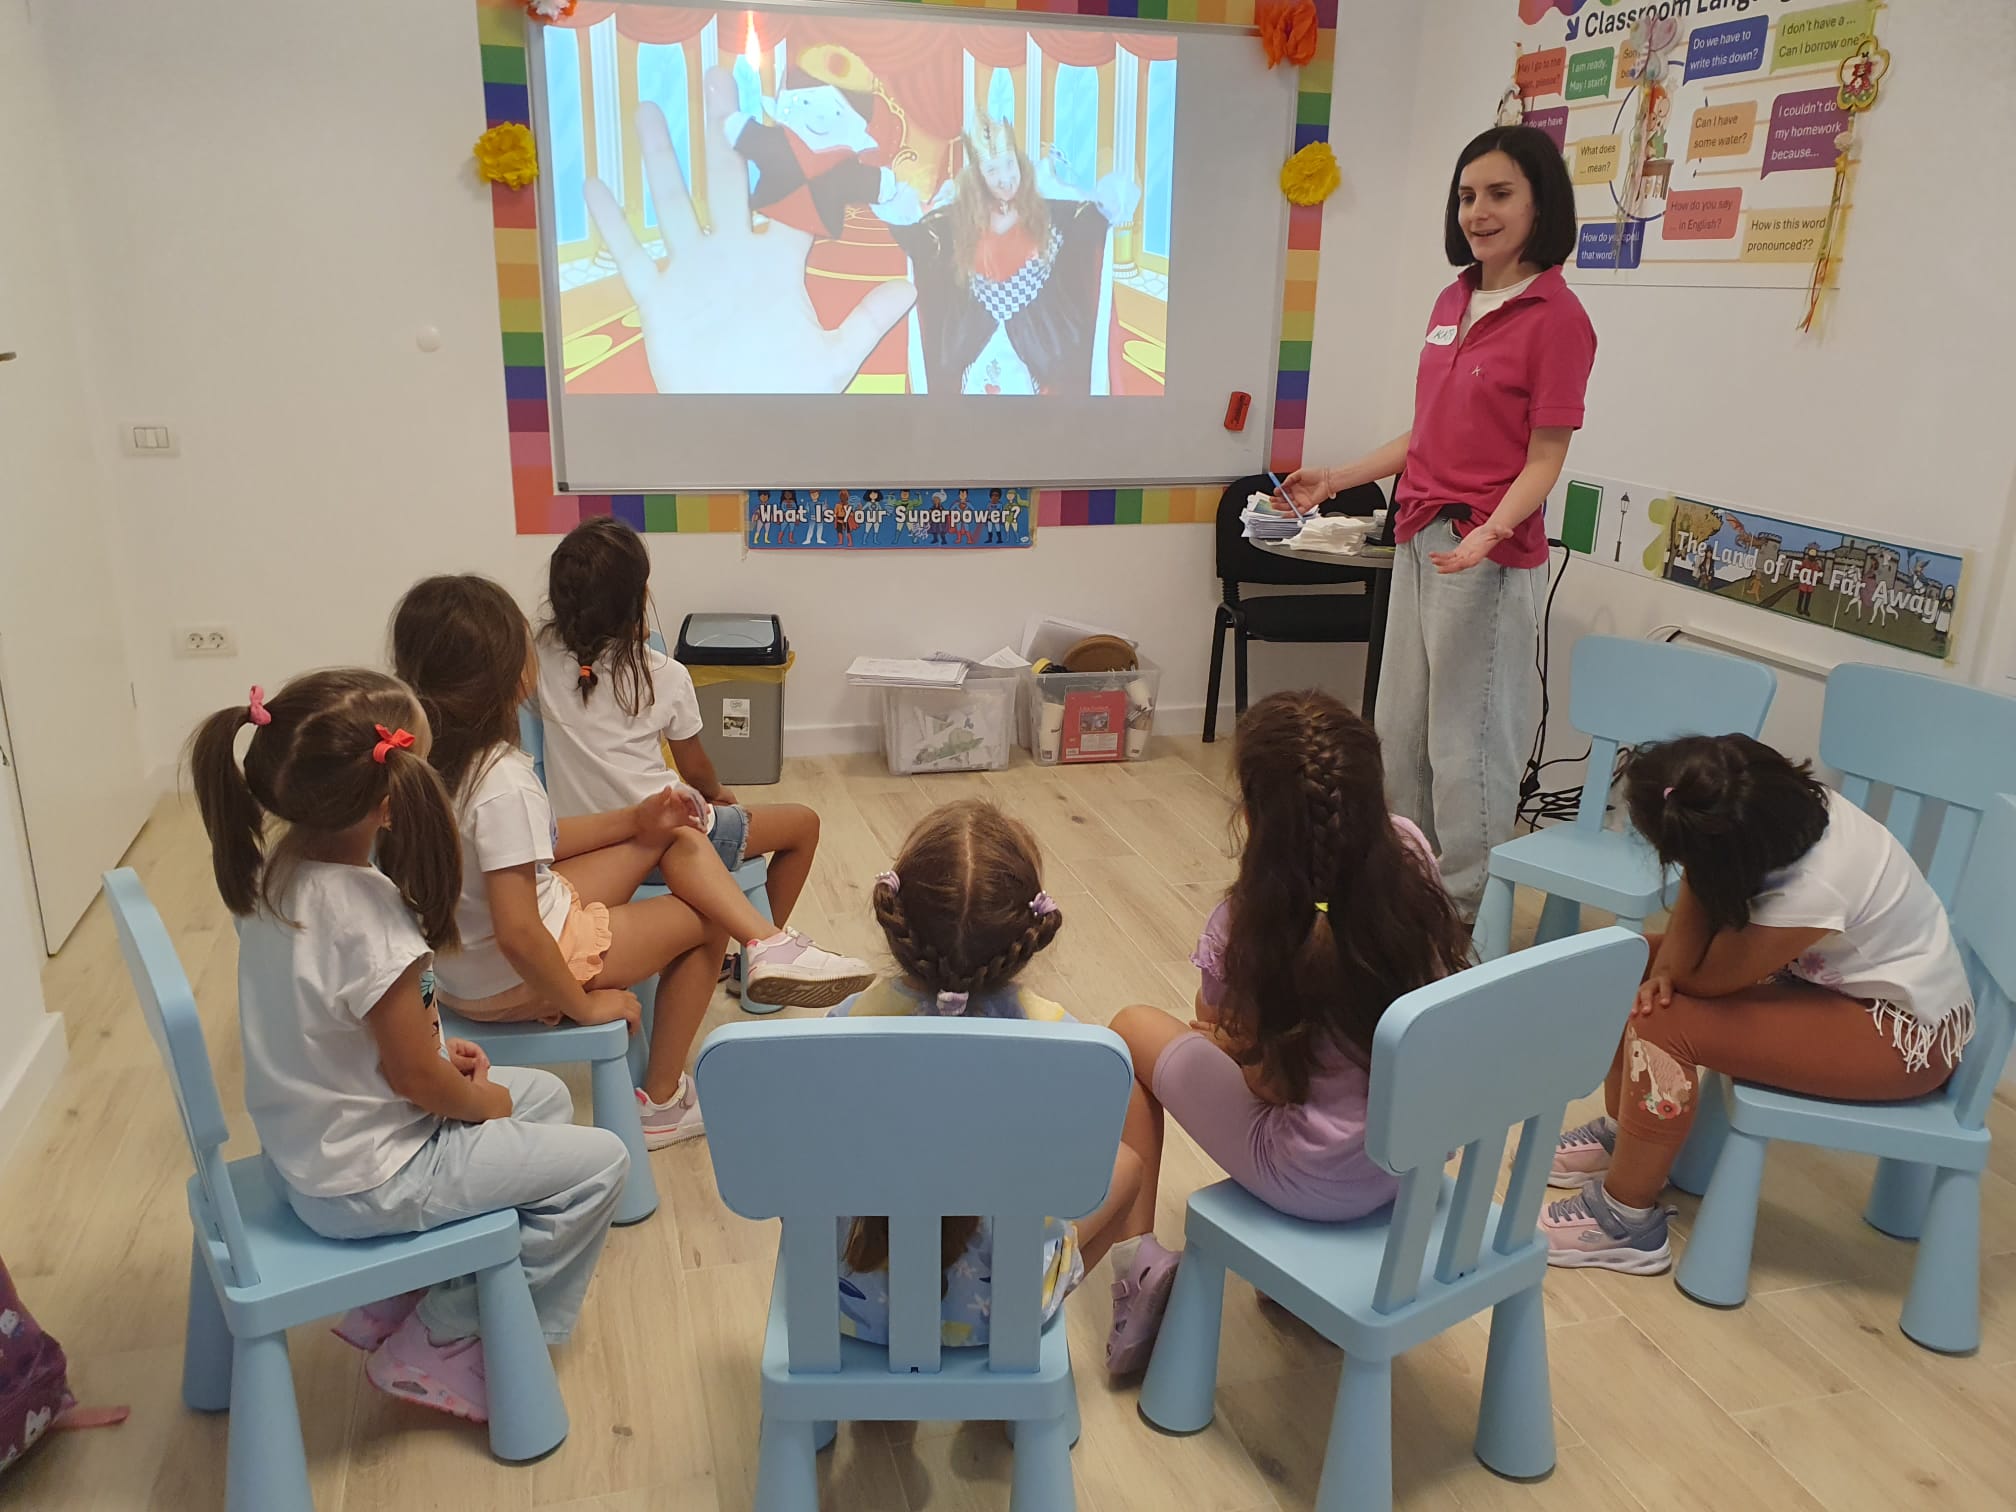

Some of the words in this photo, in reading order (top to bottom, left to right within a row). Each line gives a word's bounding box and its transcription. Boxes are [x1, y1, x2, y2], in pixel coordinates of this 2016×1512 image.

[1585, 0, 1690, 37] Classroom
[1782, 25, 1785, 36] I
[1787, 20, 1812, 35] don't
[1814, 18, 1837, 30] have
[1838, 16, 1845, 25] a
[1693, 38, 1705, 49] Do
[1706, 37, 1719, 47] we
[1720, 32, 1741, 45] have
[1742, 30, 1751, 40] to
[1779, 46, 1798, 58] Can
[1800, 43, 1803, 54] I
[1805, 40, 1839, 53] borrow
[1690, 57, 1710, 70] write
[1712, 53, 1730, 66] this
[1731, 48, 1759, 63] down?
[1569, 80, 1583, 91] May
[1587, 76, 1608, 88] start?
[1783, 101, 1823, 116] couldn't
[1824, 100, 1837, 112] do
[1695, 117, 1712, 128] Can
[1718, 114, 1738, 126] have
[1775, 129, 1790, 140] my
[1791, 122, 1842, 137] homework
[1694, 137, 1716, 148] some
[1718, 132, 1748, 146] water?
[1581, 145, 1598, 156] What
[1599, 143, 1616, 154] does
[1587, 162, 1611, 173] mean?
[1671, 200, 1689, 211] How
[1689, 200, 1700, 210] do
[1701, 201, 1717, 213] you
[1718, 200, 1733, 211] say
[1679, 219, 1686, 230] in
[1687, 218, 1722, 232] English?
[1751, 219, 1771, 230] How
[1773, 218, 1781, 229] is
[1782, 217, 1800, 229] this
[1801, 216, 1827, 229] word
[1583, 231, 1598, 242] How
[1599, 232, 1608, 242] do
[1747, 239, 1814, 253] pronounced??
[1582, 250, 1595, 260] that
[760, 504, 807, 523] What
[815, 504, 835, 523] Is
[841, 504, 887, 523] Your
[895, 505, 1020, 528] Superpower?
[1678, 530, 1707, 557] The
[1712, 540, 1759, 571] Land
[1763, 554, 1786, 584] of
[1789, 559, 1824, 587] Far
[1828, 569, 1866, 597] Far
[1871, 580, 1940, 625] Away
